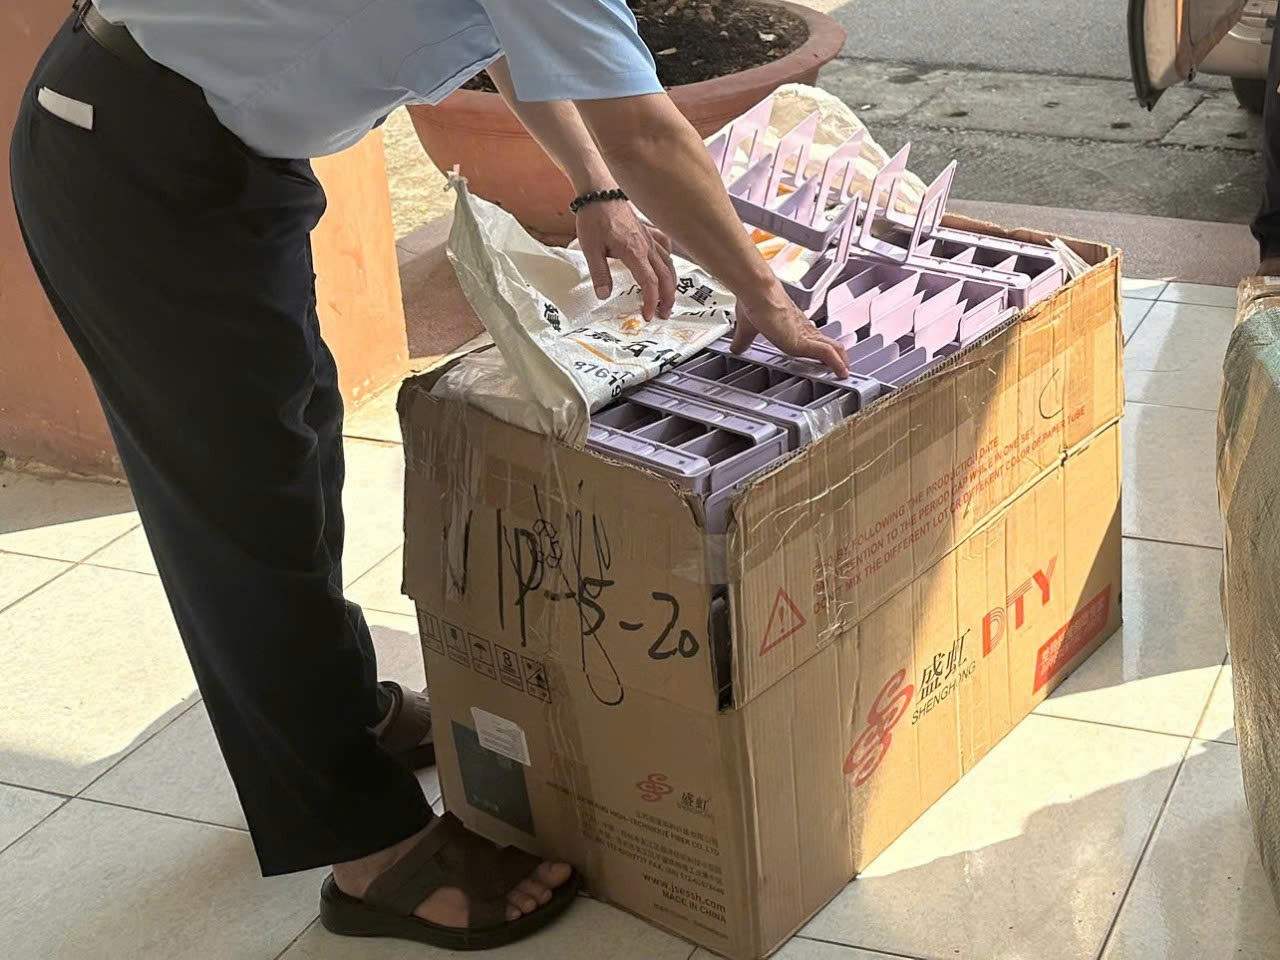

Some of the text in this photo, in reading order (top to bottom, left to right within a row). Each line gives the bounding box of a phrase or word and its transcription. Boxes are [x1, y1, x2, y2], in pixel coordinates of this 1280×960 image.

[851, 504, 905, 548] FOLLOWING
[907, 491, 925, 508] THE
[887, 528, 898, 543] TO
[900, 513, 917, 531] THE
[919, 490, 951, 520] PERIOD
[952, 476, 968, 496] GAP
[844, 575, 862, 593] MIX
[864, 558, 883, 577] THE
[884, 521, 931, 564] DIFFERENT
[933, 507, 949, 528] LOT
[981, 556, 1058, 658] DTY
[911, 660, 977, 726] SHENGHONG
